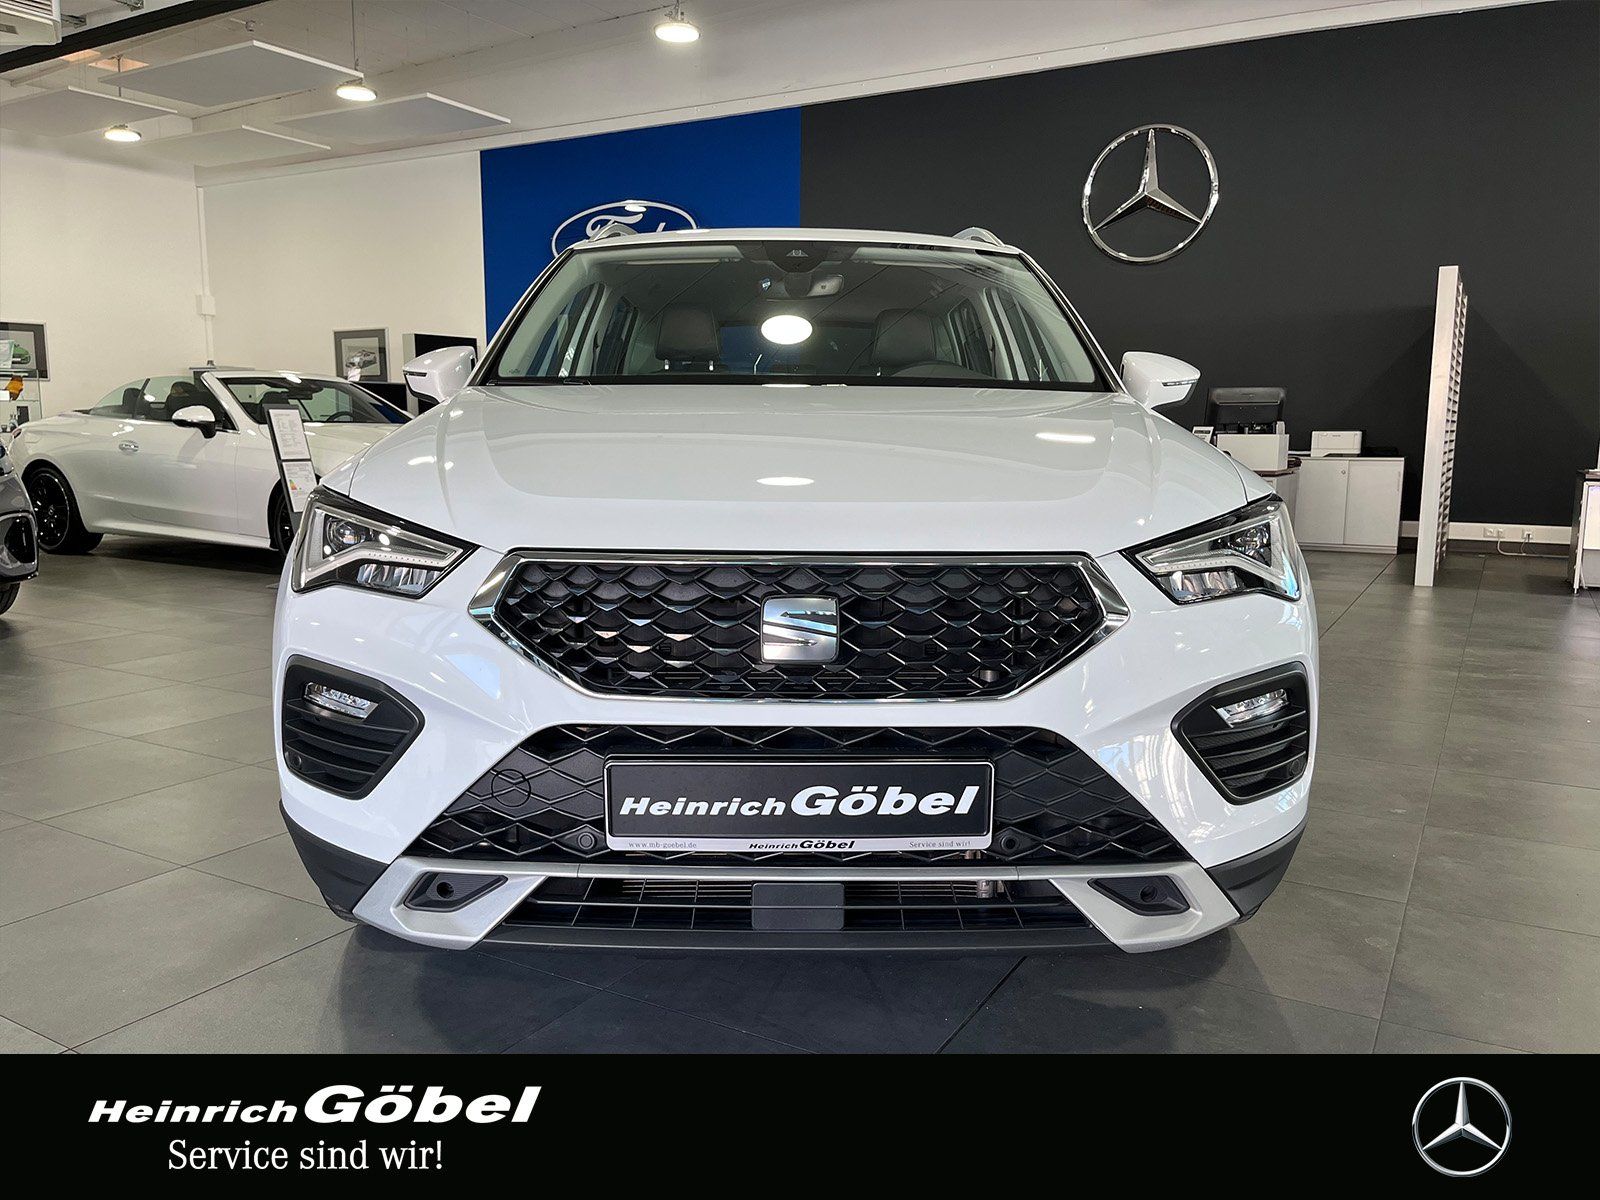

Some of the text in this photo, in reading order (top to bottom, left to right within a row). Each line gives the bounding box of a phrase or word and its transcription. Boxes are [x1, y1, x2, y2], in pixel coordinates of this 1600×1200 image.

[619, 785, 980, 816] Heinrich Göbel
[628, 841, 697, 849] www.mb-goebel.de
[799, 840, 855, 849] Göbel
